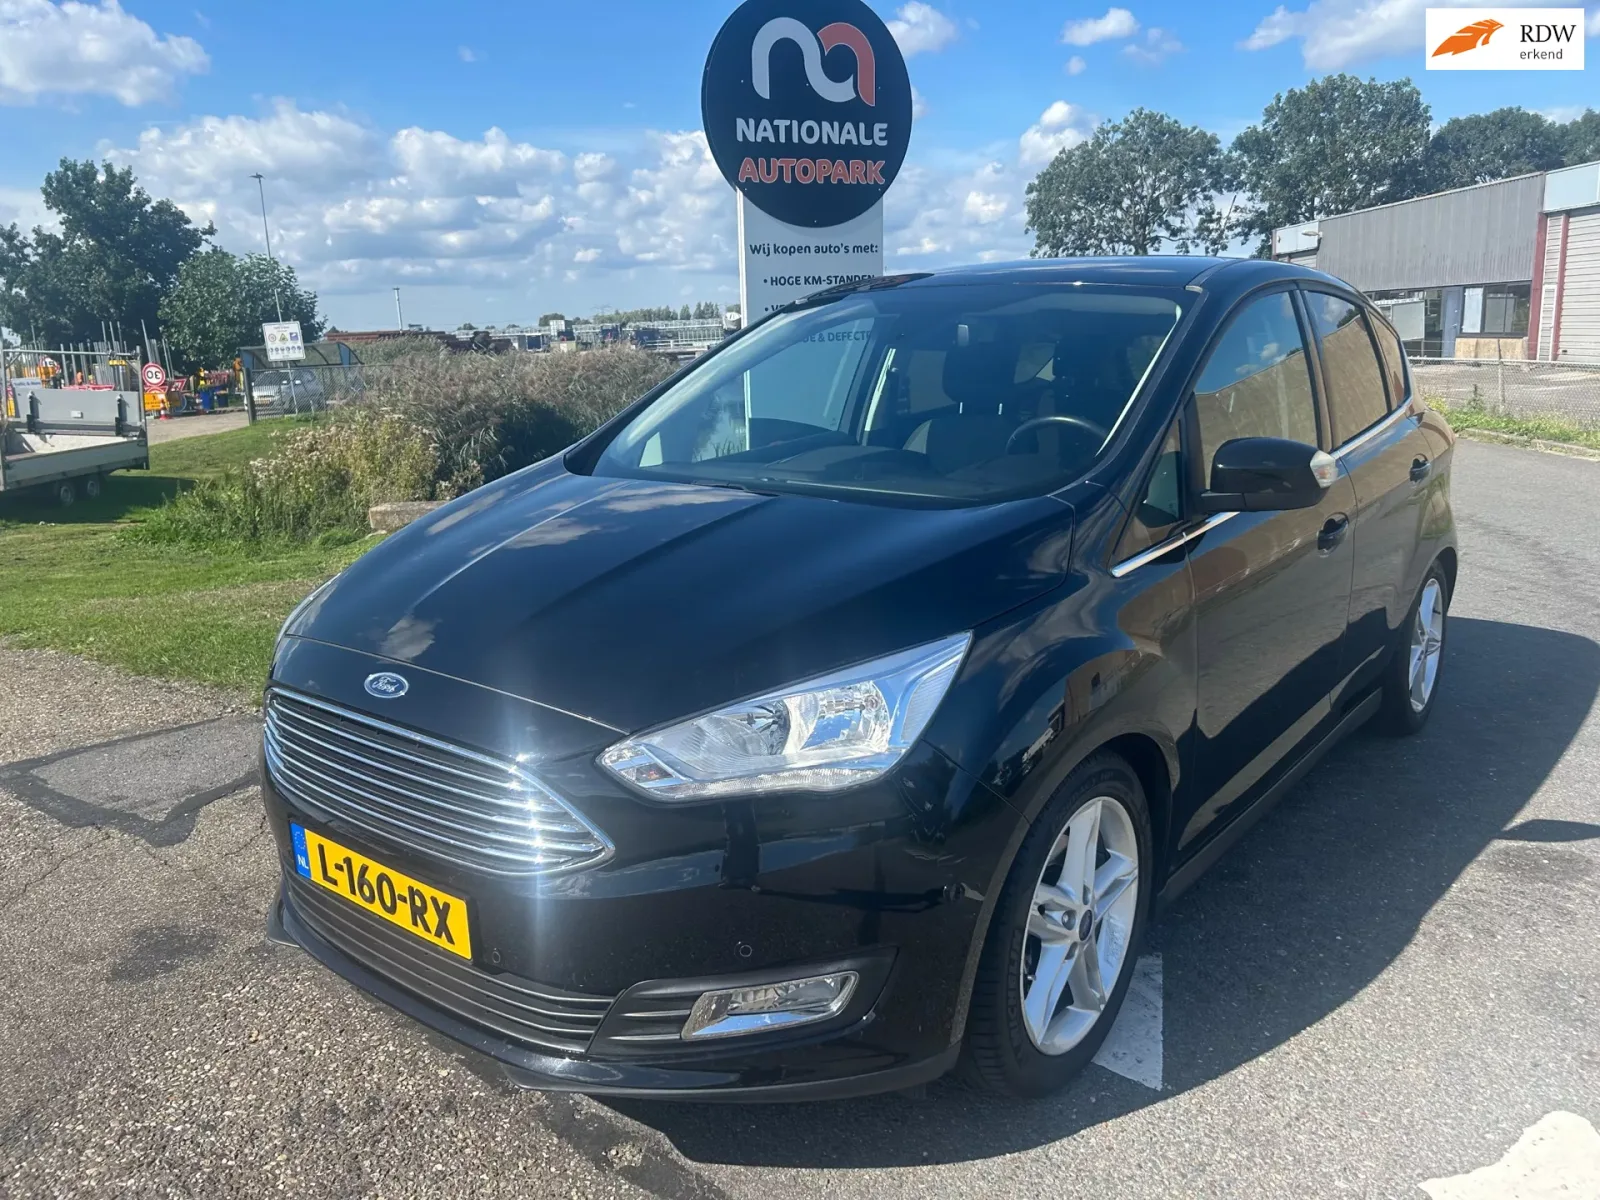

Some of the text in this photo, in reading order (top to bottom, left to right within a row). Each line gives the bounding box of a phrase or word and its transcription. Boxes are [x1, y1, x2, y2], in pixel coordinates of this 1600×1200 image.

[736, 117, 888, 146] NATIONALE
[738, 157, 886, 185] AUTOPARK
[749, 243, 878, 257] Wij kopen auto's met:
[770, 276, 801, 286] HOGE
[297, 854, 309, 870] NL
[318, 843, 456, 945] L-160-RX
